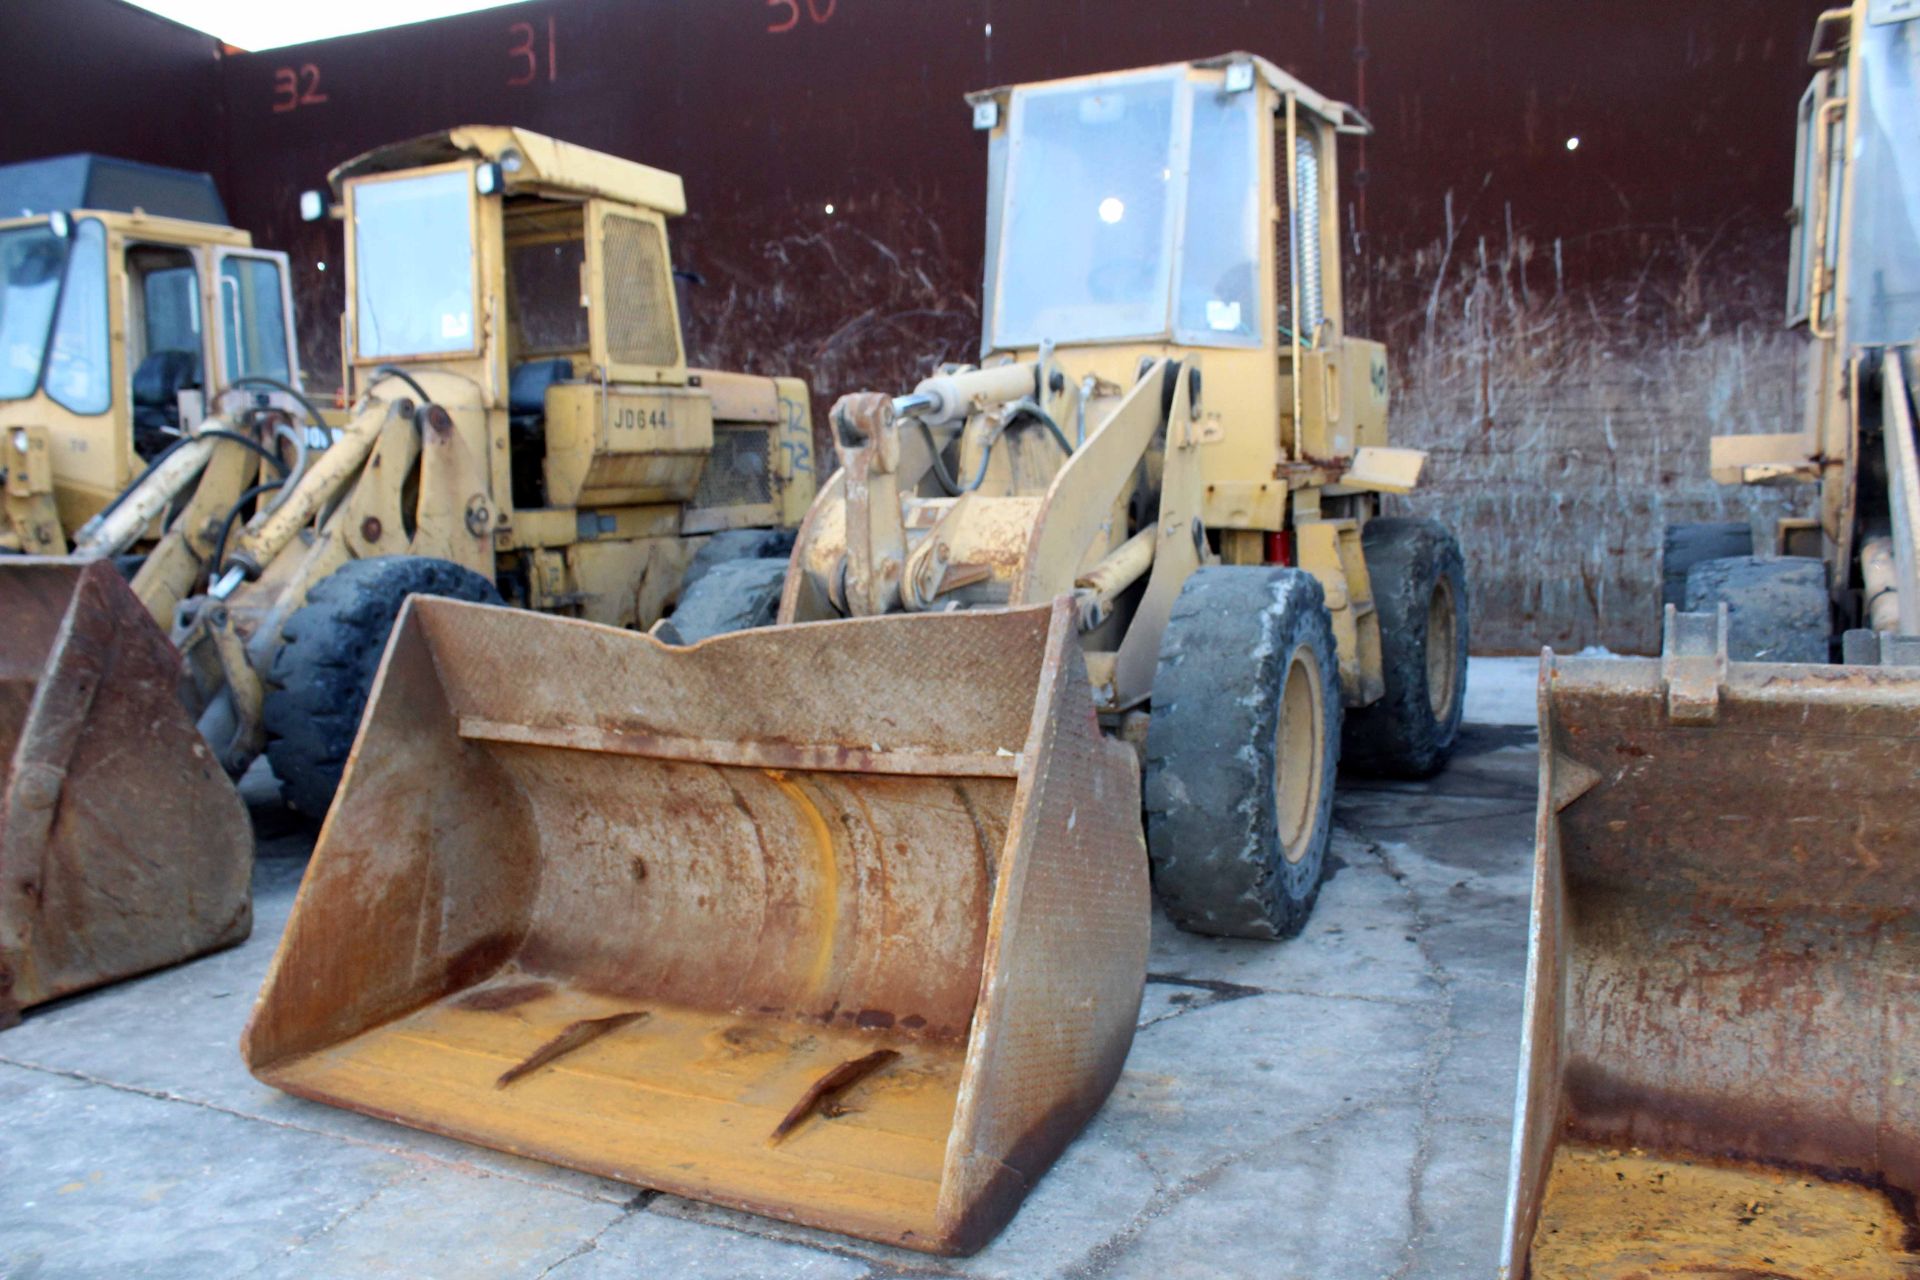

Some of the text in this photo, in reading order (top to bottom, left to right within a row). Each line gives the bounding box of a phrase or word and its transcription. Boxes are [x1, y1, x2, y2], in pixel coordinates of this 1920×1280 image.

[508, 19, 558, 87] 31
[273, 64, 328, 112] 32
[615, 409, 667, 430] JD644
